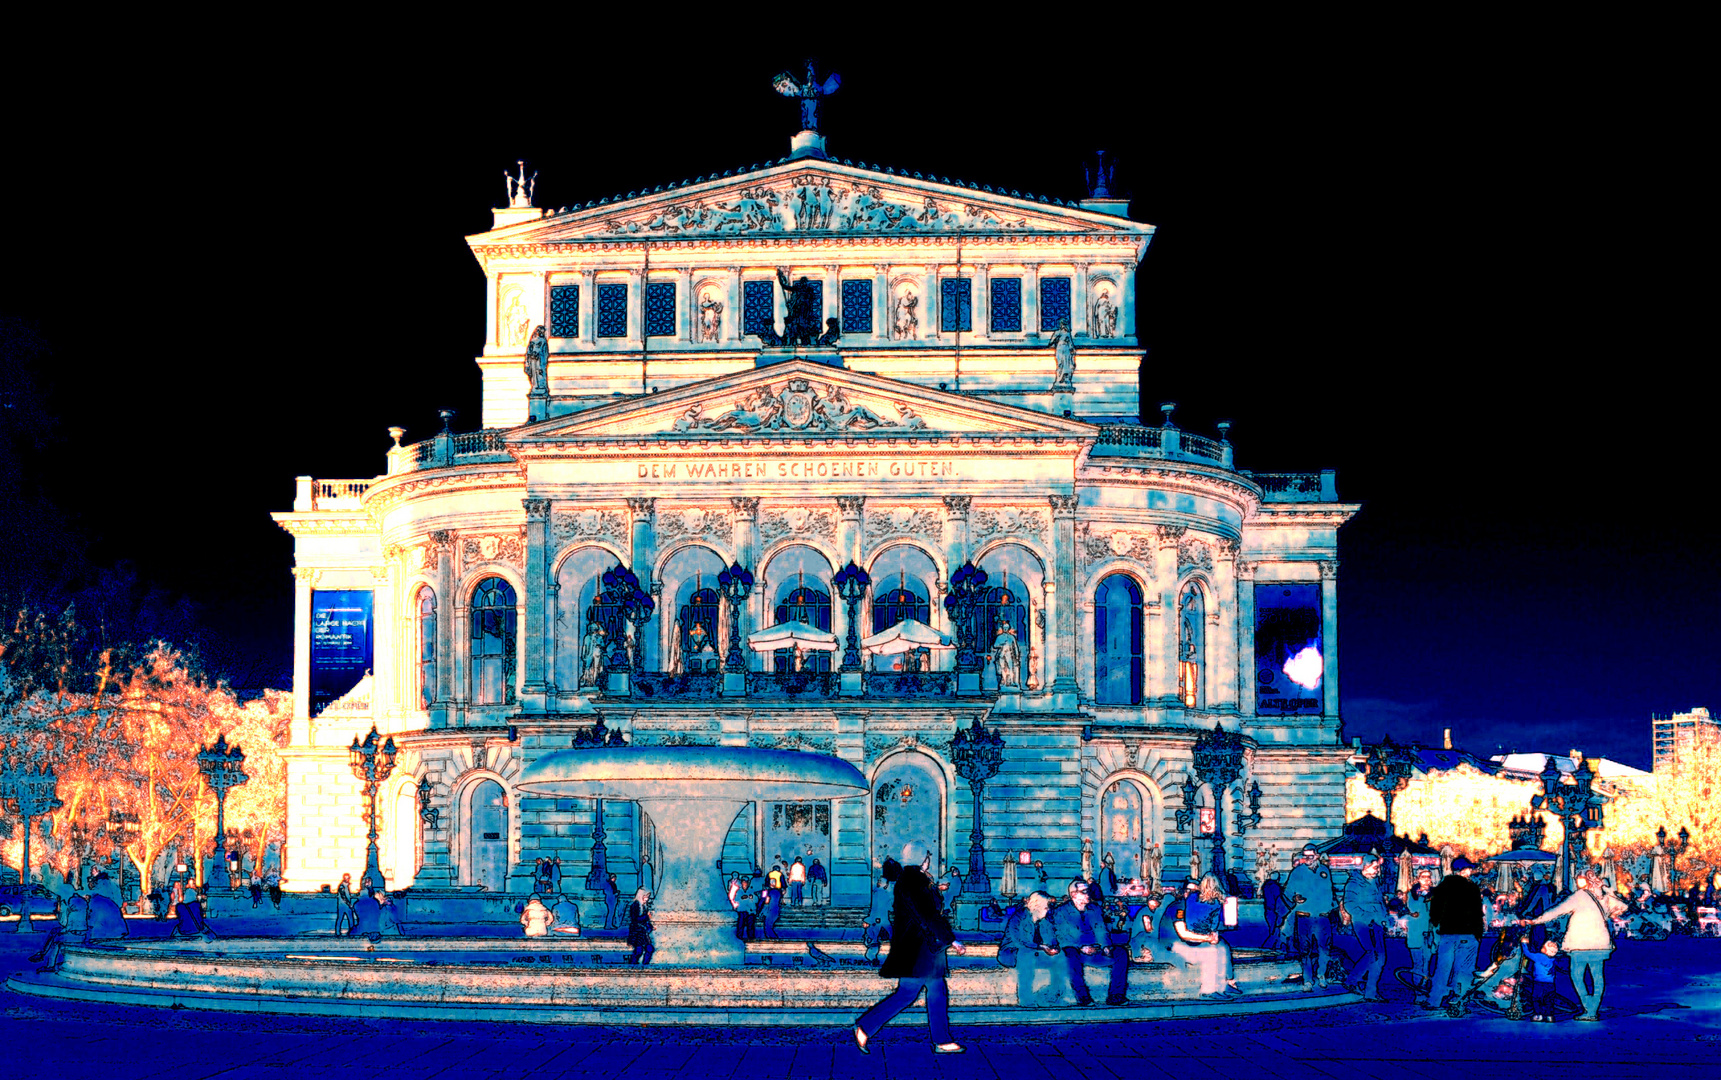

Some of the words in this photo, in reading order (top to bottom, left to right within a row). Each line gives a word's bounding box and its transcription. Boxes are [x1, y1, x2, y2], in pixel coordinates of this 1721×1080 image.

[638, 463, 676, 478] DEM
[686, 463, 766, 478] WAHREN
[778, 462, 879, 477] SCHOENEN
[889, 462, 960, 476] GUTEN.
